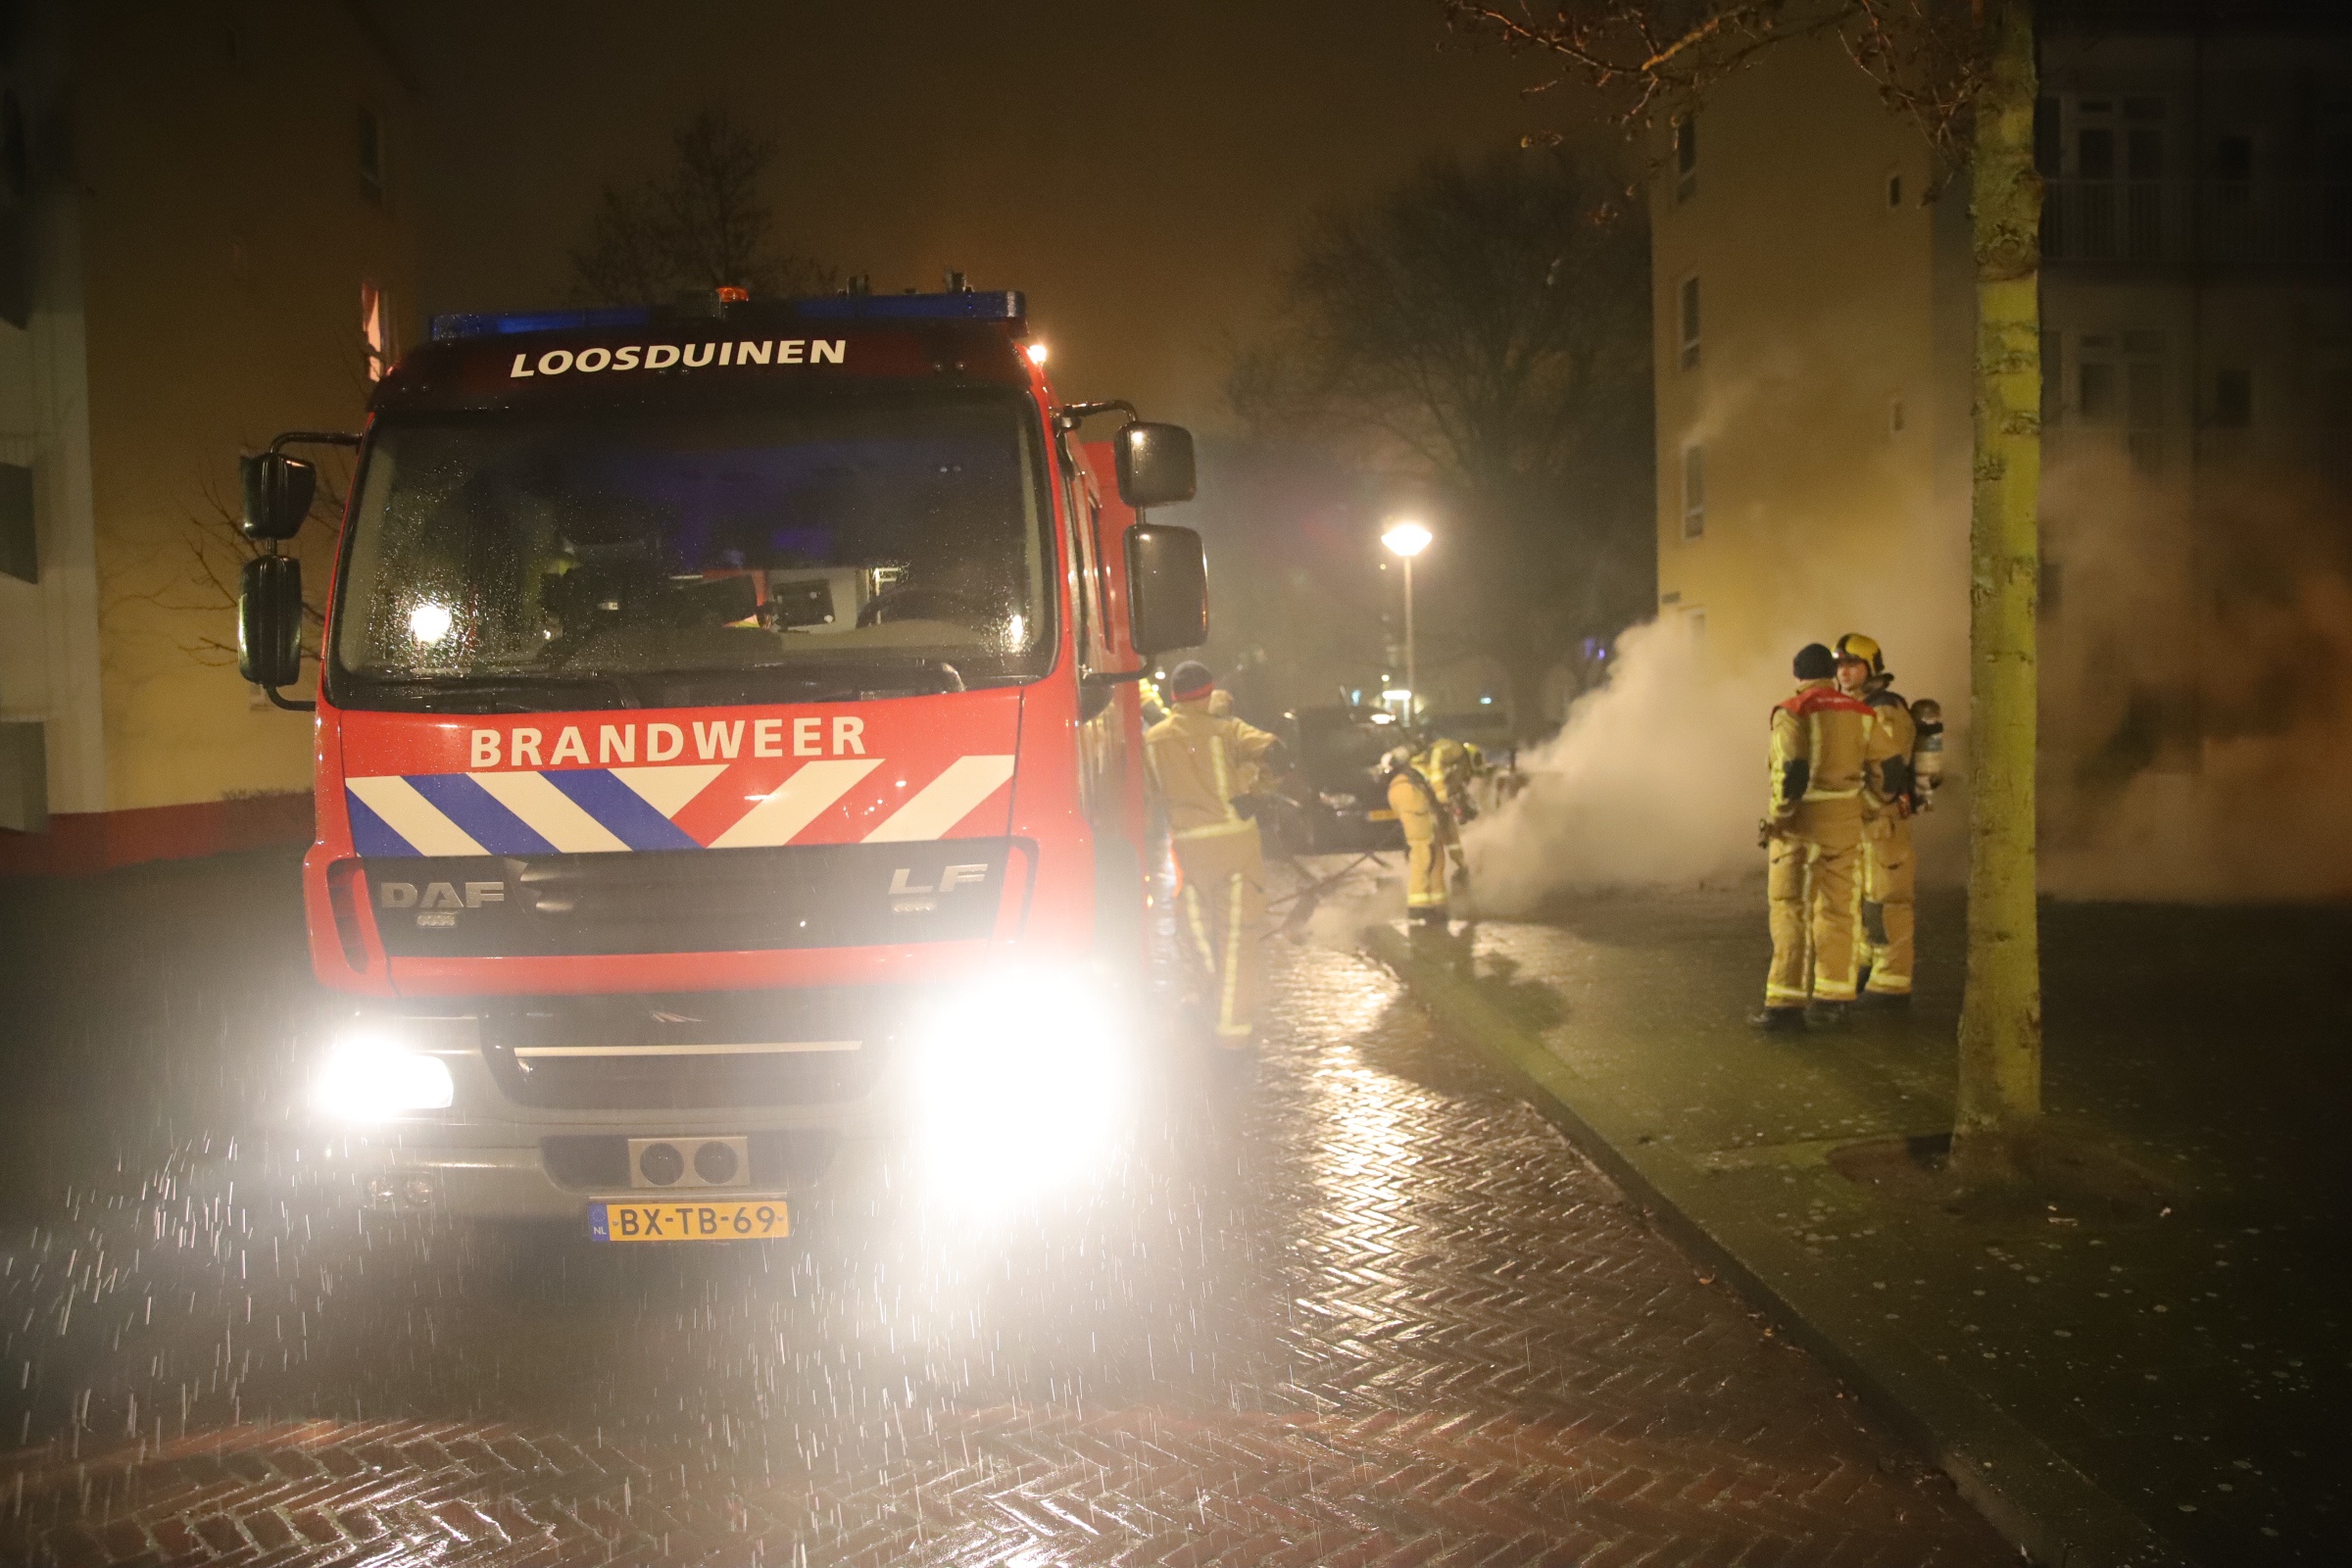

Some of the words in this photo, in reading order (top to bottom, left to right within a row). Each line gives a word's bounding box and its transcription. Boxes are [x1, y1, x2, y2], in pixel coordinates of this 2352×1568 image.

[510, 339, 846, 377] LOOSDUINEN
[470, 715, 866, 768] BRANDWEER
[381, 881, 505, 907] DAF
[888, 863, 989, 895] LF
[593, 1226, 607, 1235] NL
[619, 1205, 776, 1236] BX-TB-69
